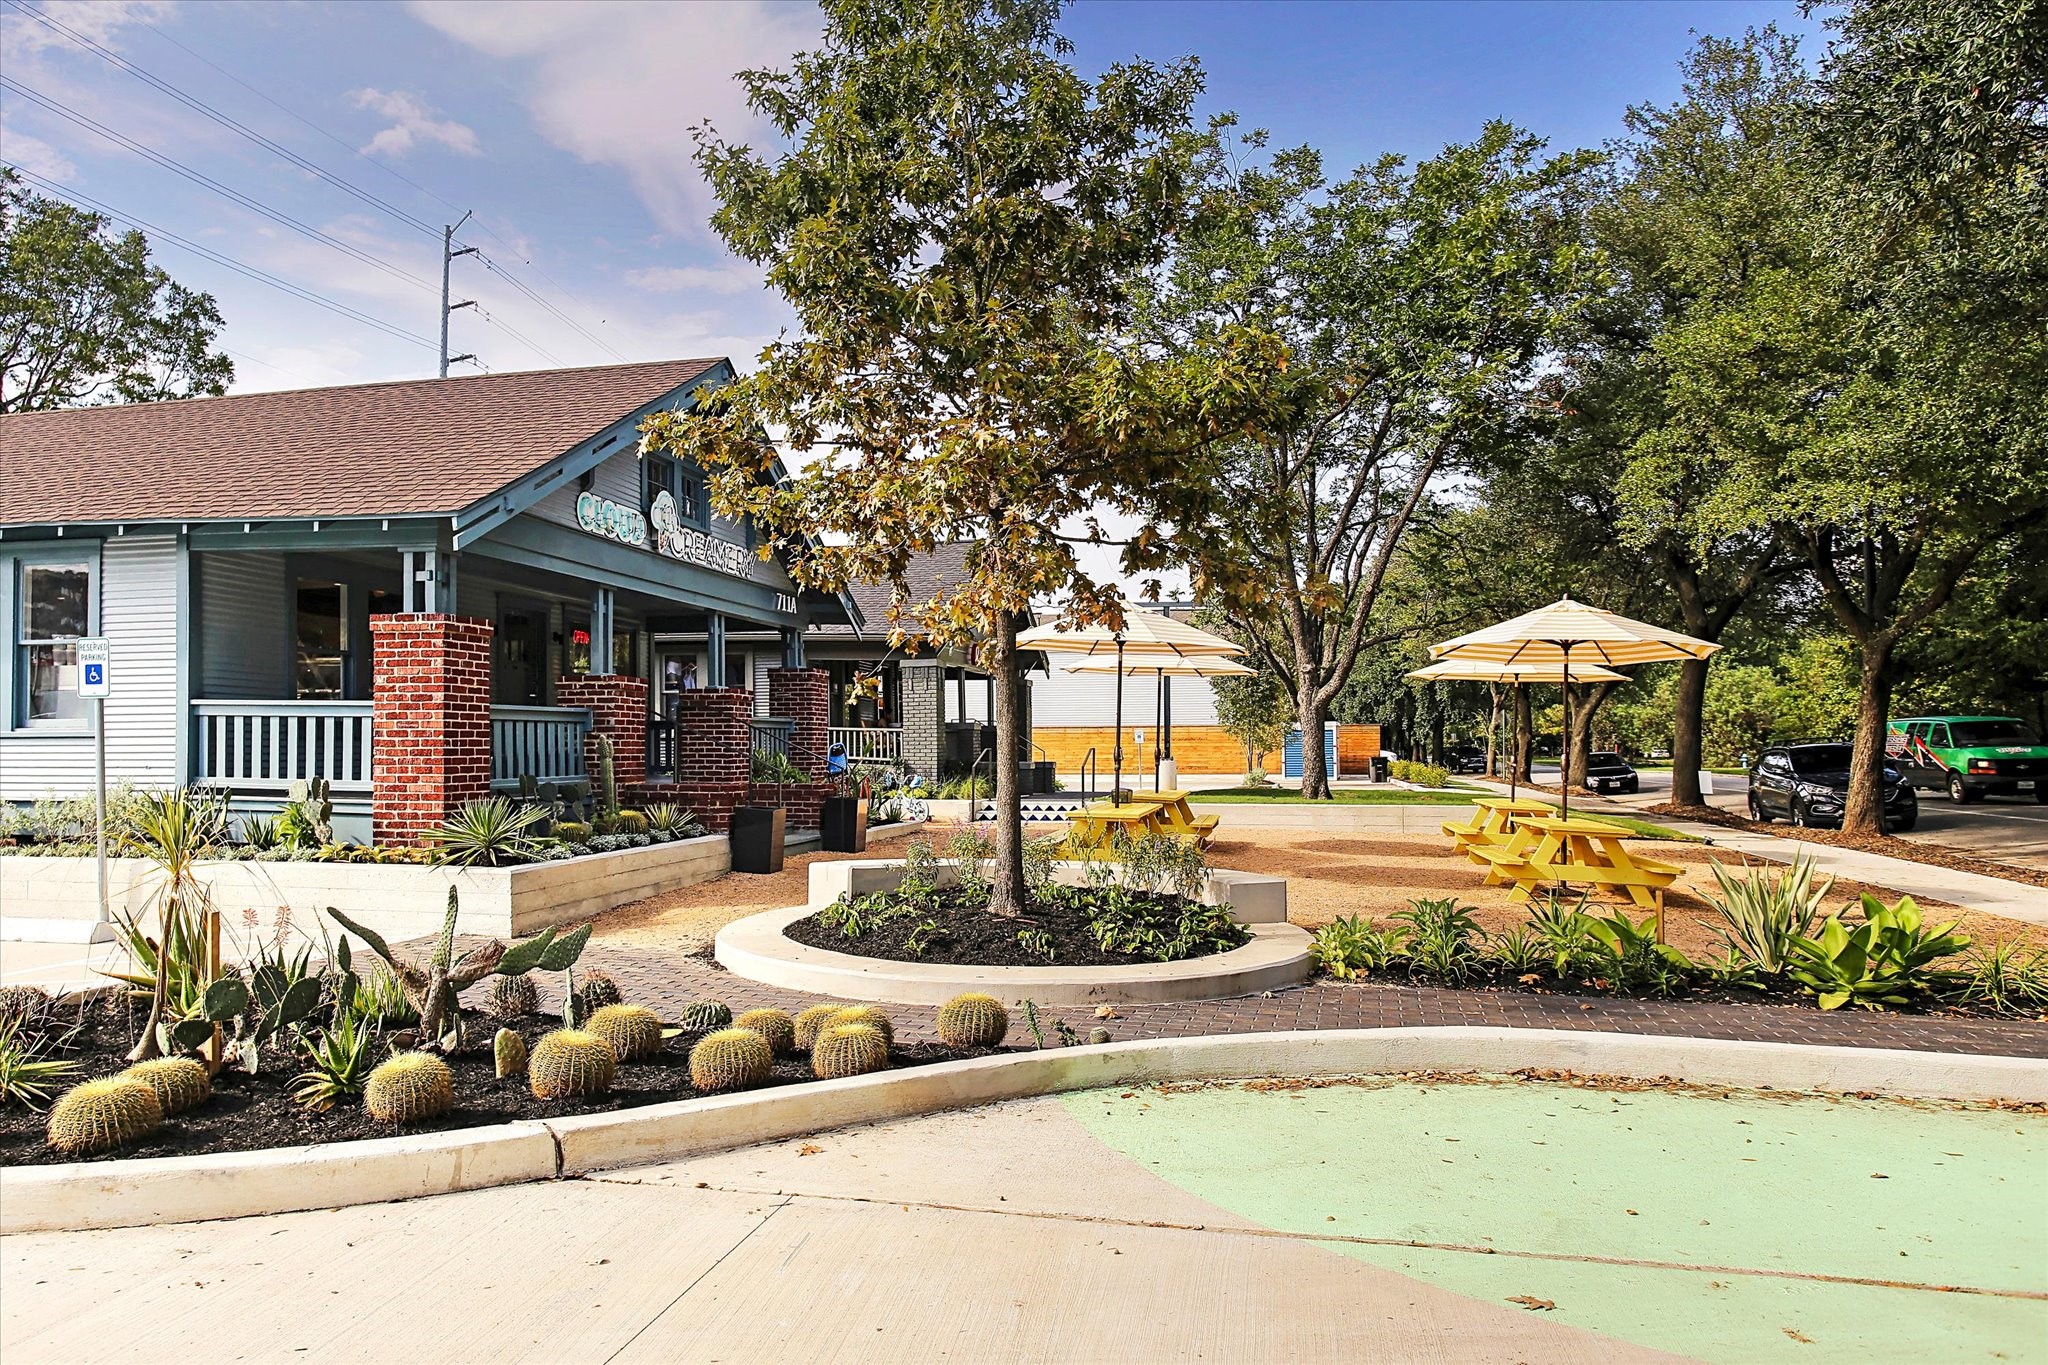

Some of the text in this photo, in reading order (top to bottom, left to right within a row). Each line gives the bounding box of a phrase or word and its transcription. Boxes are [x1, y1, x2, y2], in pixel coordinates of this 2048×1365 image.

[578, 492, 647, 545] CLOUD
[670, 527, 757, 579] CREAMERY
[776, 592, 797, 614] 711A
[79, 643, 108, 652] RESERVED
[80, 653, 106, 661] PARKING
